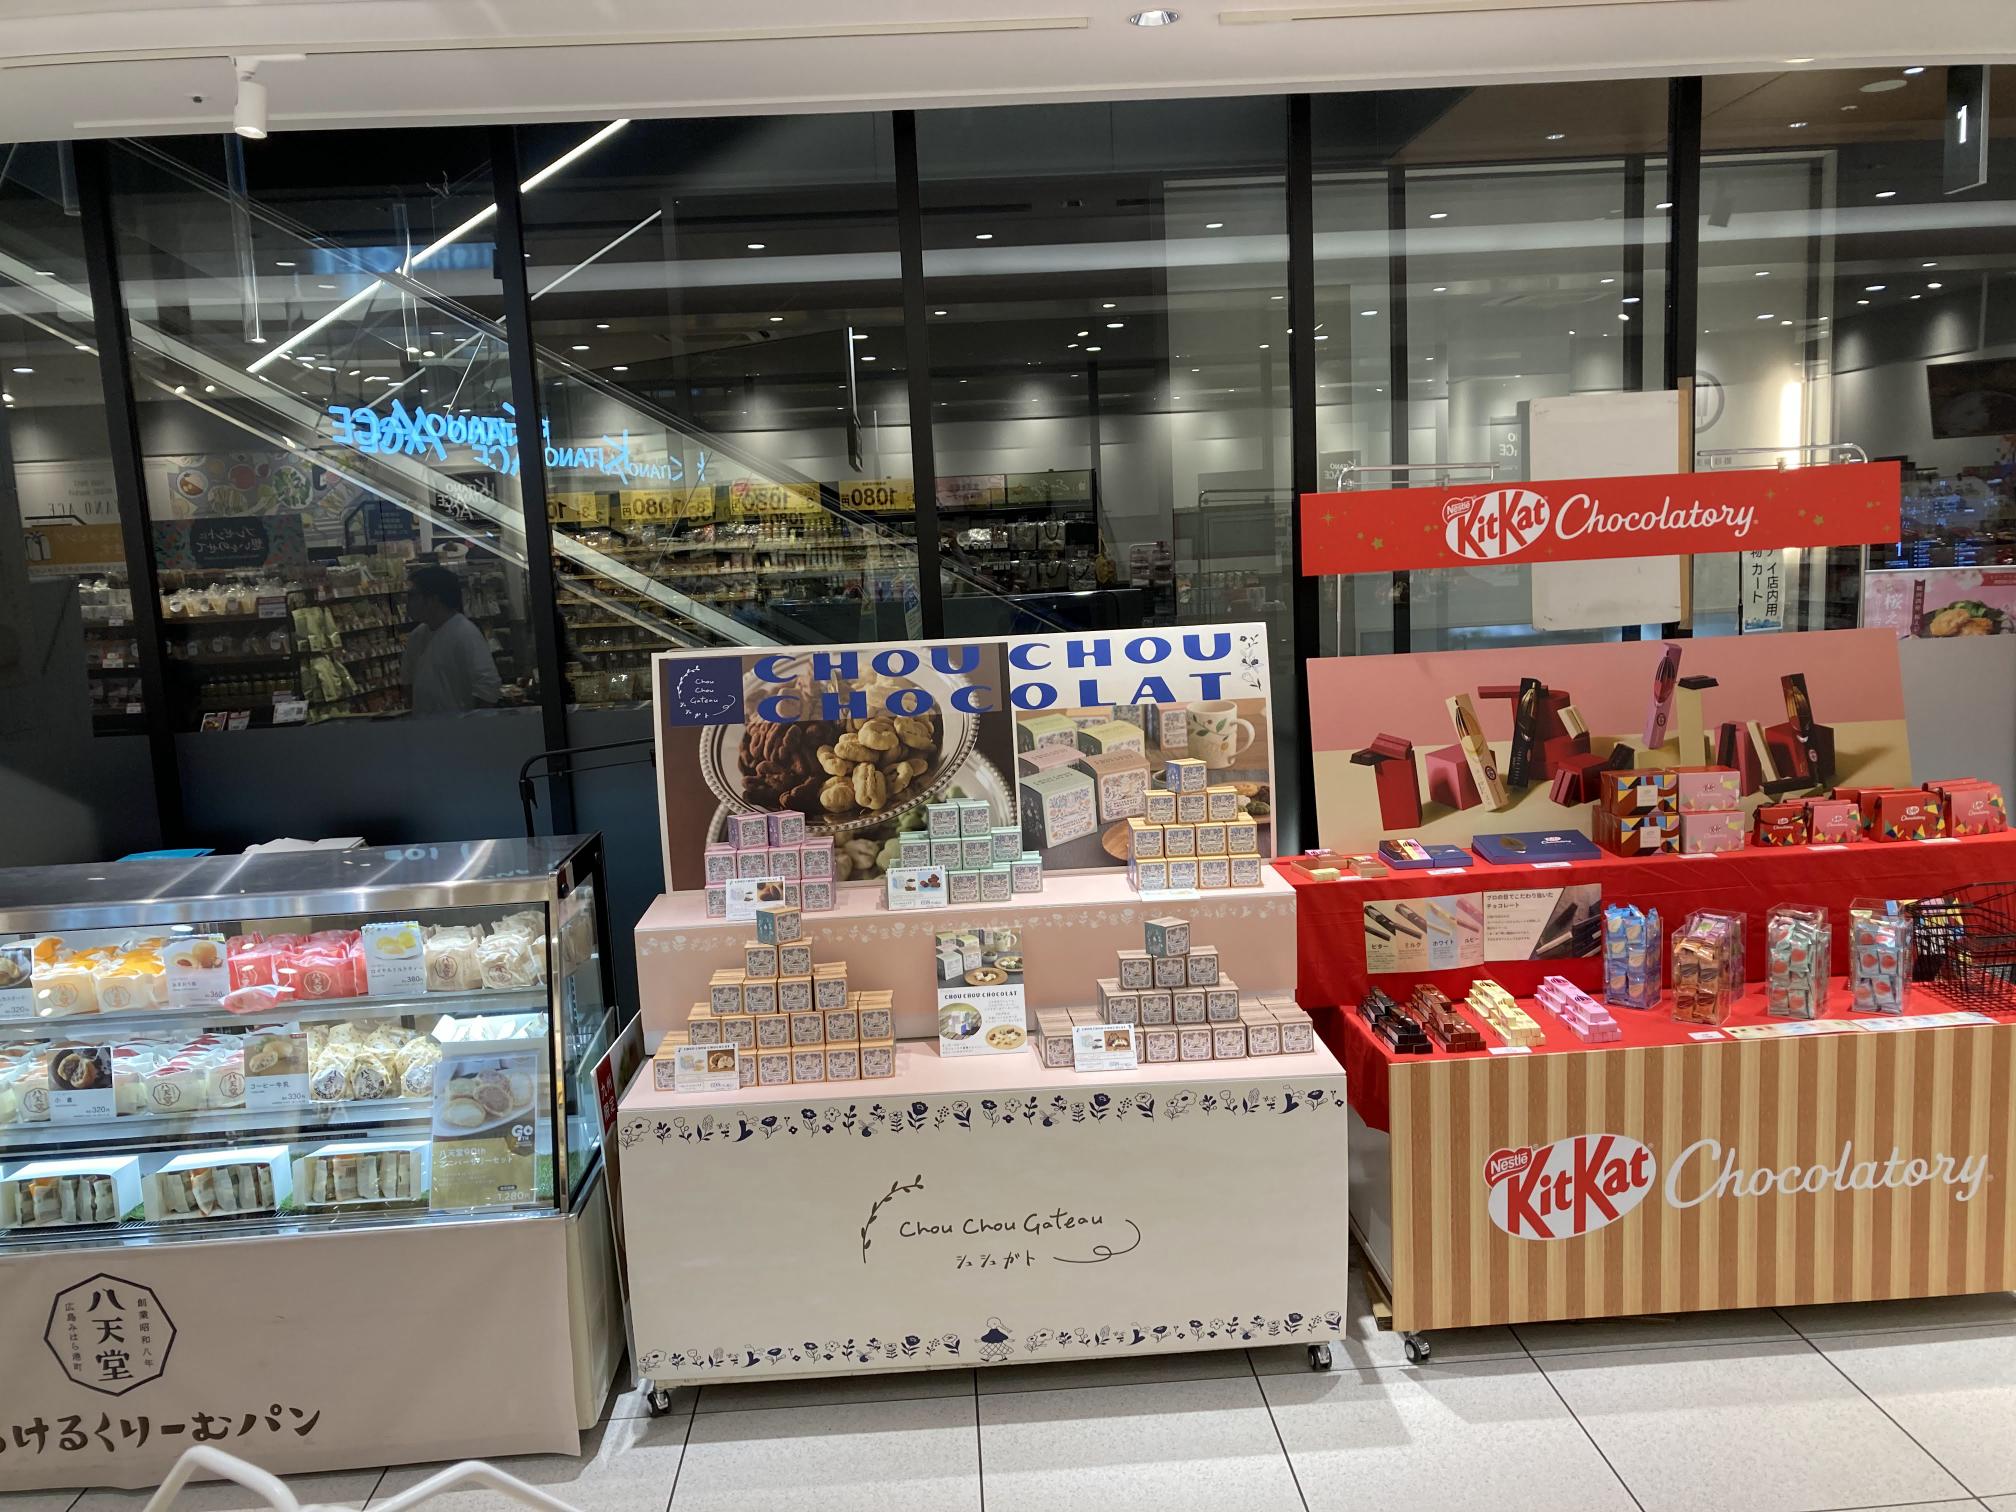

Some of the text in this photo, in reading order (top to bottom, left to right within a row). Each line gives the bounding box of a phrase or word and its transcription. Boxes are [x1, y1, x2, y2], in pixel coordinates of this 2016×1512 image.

[1957, 104, 1968, 144] 1
[1555, 493, 1755, 540] Chocolatory
[753, 632, 1232, 683] CHOU CHOU
[690, 696, 719, 704] Gateau
[756, 671, 1232, 724] CHOCOLAT
[1490, 1152, 1529, 1175] Nestlé
[1507, 1134, 1989, 1238] KitKat Chocolatory
[899, 1207, 1104, 1238] Chou Chou Gateau
[955, 1249, 1036, 1270] シュシュガト
[64, 1302, 82, 1371] 広島みはら港町
[86, 1288, 134, 1381] 八天堂
[137, 1298, 154, 1368] 創業昭和八年
